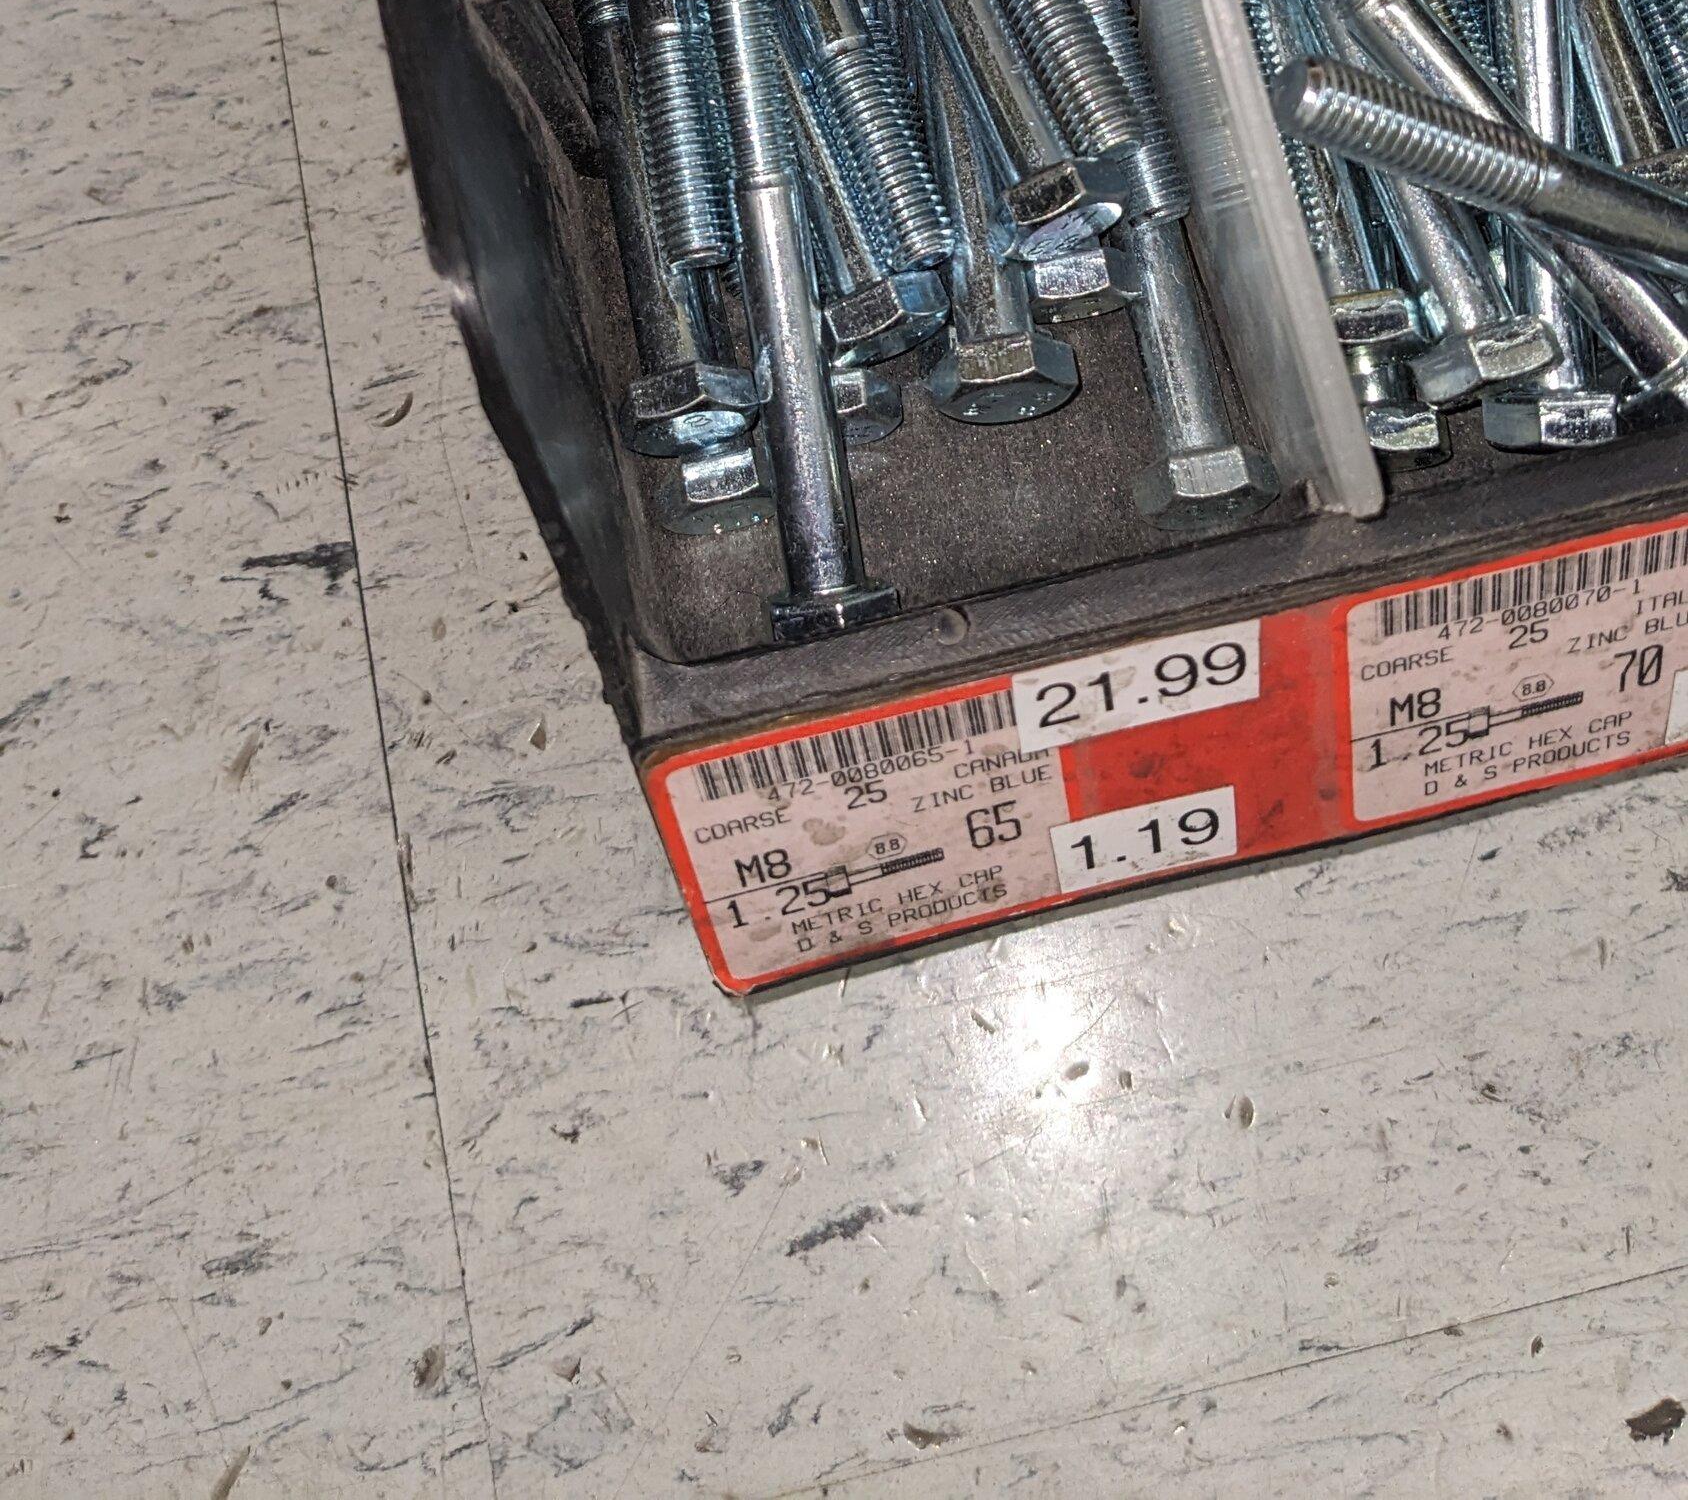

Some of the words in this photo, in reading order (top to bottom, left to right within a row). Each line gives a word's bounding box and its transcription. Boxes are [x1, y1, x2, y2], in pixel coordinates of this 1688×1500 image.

[1438, 579, 1640, 640] 472-0080070-1
[1509, 618, 1549, 649] 25
[1361, 646, 1453, 681] COARSE
[1568, 625, 1628, 654] ZINC
[1036, 642, 1246, 728] 21.99
[1522, 680, 1546, 696] 8.8
[1614, 644, 1664, 692] 70
[1390, 688, 1441, 726] M8
[1371, 718, 1468, 769] 1.25
[1425, 742, 1513, 776] METRIC
[1529, 725, 1573, 749] HEX
[1588, 711, 1632, 733] CAP
[1425, 780, 1437, 795] D
[1455, 774, 1467, 788] &
[1485, 765, 1497, 780] S
[1513, 731, 1630, 772] PRODUCTS
[768, 739, 975, 802] 472-0080065-1
[844, 780, 887, 809] 25
[912, 784, 974, 812] ZINC
[990, 764, 1052, 793] BLUE
[695, 807, 791, 844] COARSE
[966, 800, 1022, 848] 65
[1071, 808, 1219, 869] 1.19
[734, 849, 792, 887] M8
[727, 878, 830, 928] 1.25
[792, 898, 883, 935] METRIC
[899, 881, 944, 905] HEX
[959, 865, 1002, 888] CAP
[830, 930, 843, 944] &
[858, 920, 873, 935] S
[887, 884, 1007, 928] PRODUCTS
